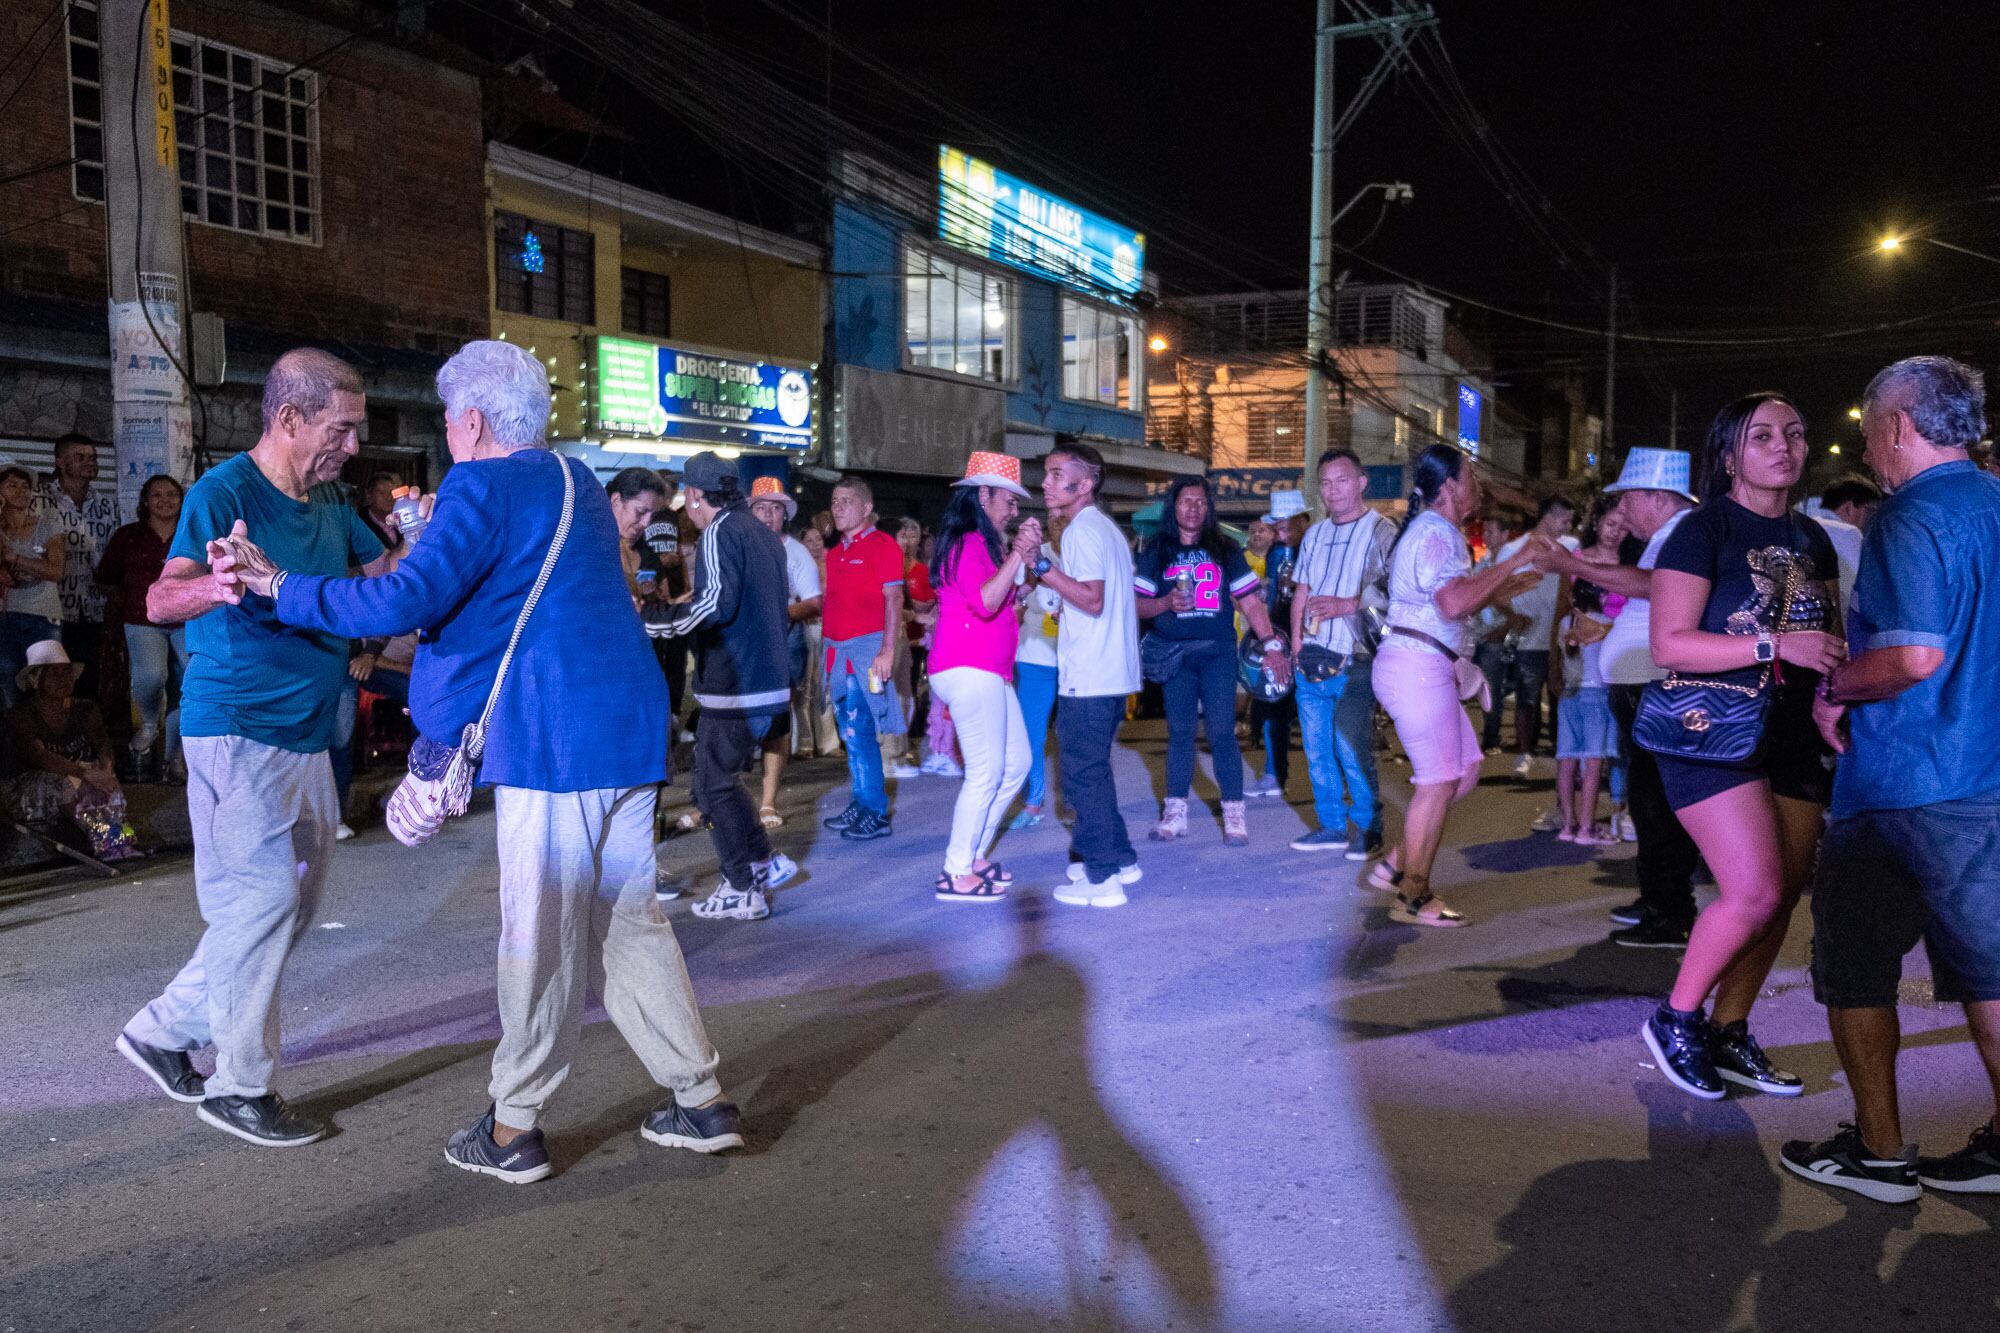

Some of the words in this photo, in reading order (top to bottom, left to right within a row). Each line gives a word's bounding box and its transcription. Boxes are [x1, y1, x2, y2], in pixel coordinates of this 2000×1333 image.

[664, 372, 716, 400] SUPER
[718, 380, 777, 411] DROGAS
[499, 1152, 521, 1168] Reebok
